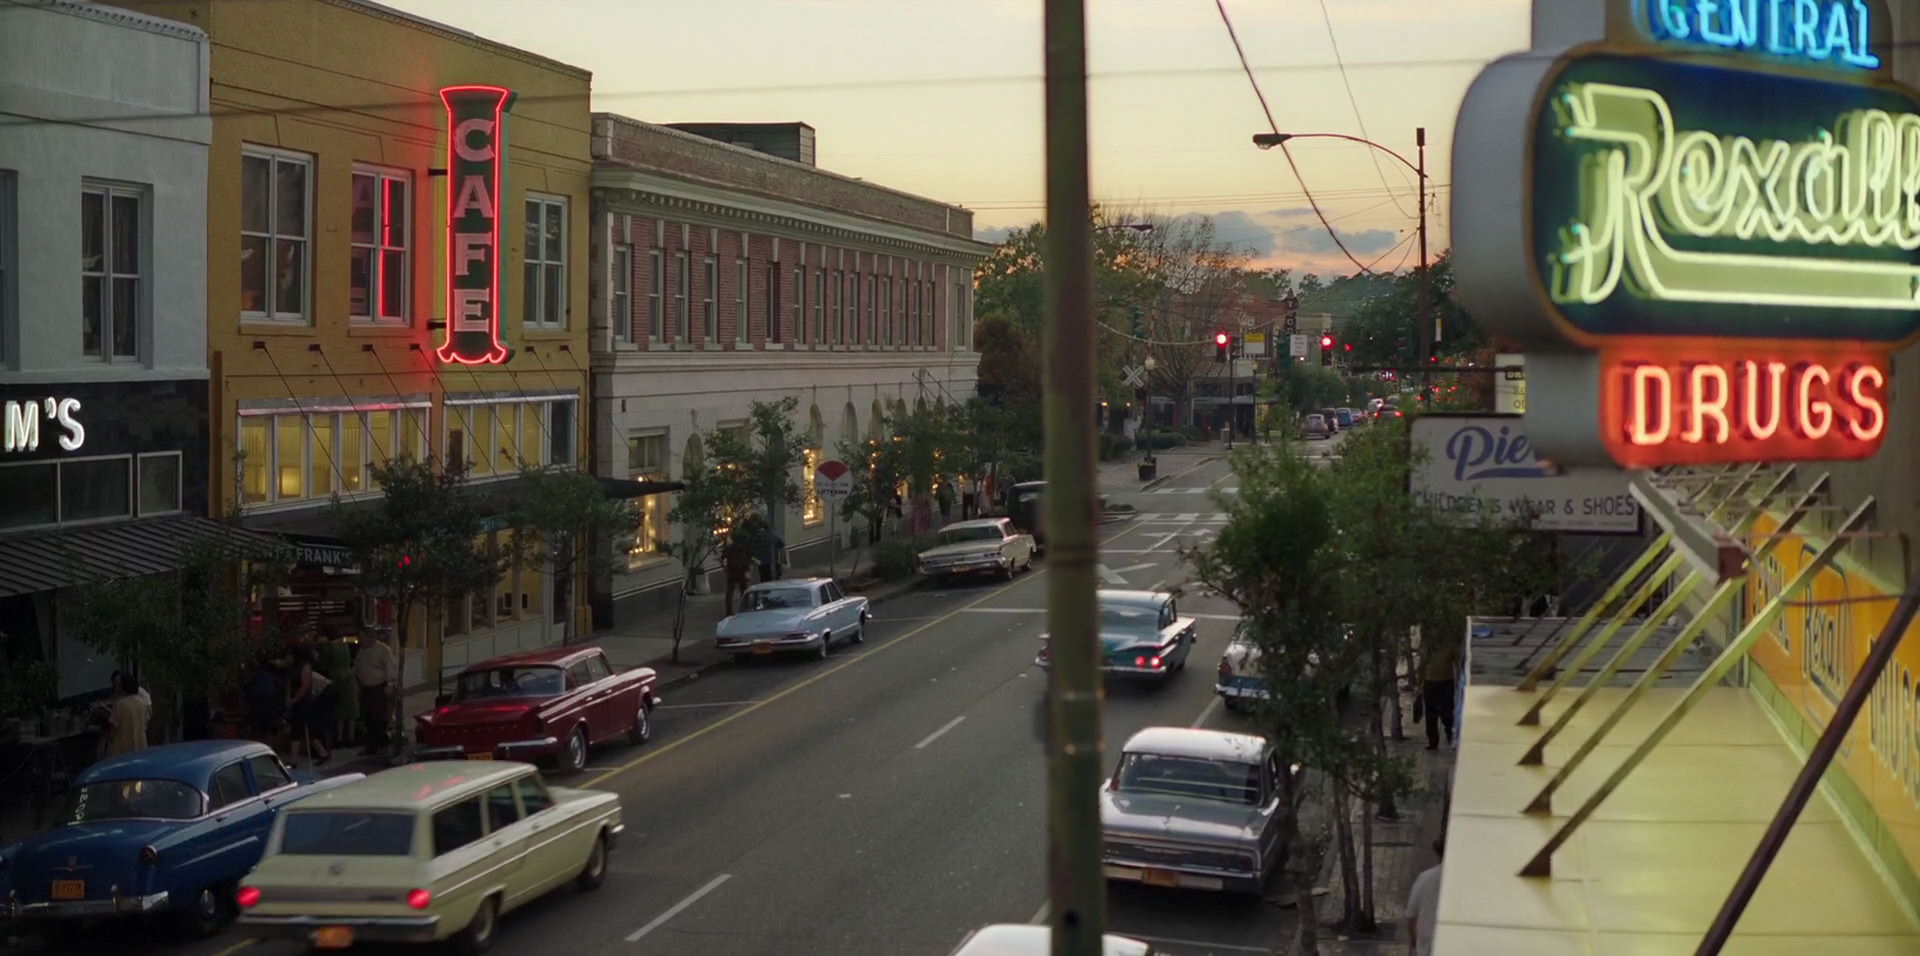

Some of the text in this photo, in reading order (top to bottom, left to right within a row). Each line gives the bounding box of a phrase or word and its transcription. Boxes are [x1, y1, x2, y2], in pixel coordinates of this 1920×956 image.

[453, 118, 496, 333] CAFE
[1552, 82, 1920, 308] Rexall
[5, 397, 85, 452] M'S
[1630, 361, 1884, 445] DRUGS
[1446, 426, 1534, 481] Pie
[1563, 498, 1574, 515] &
[1583, 495, 1635, 516] SHOES
